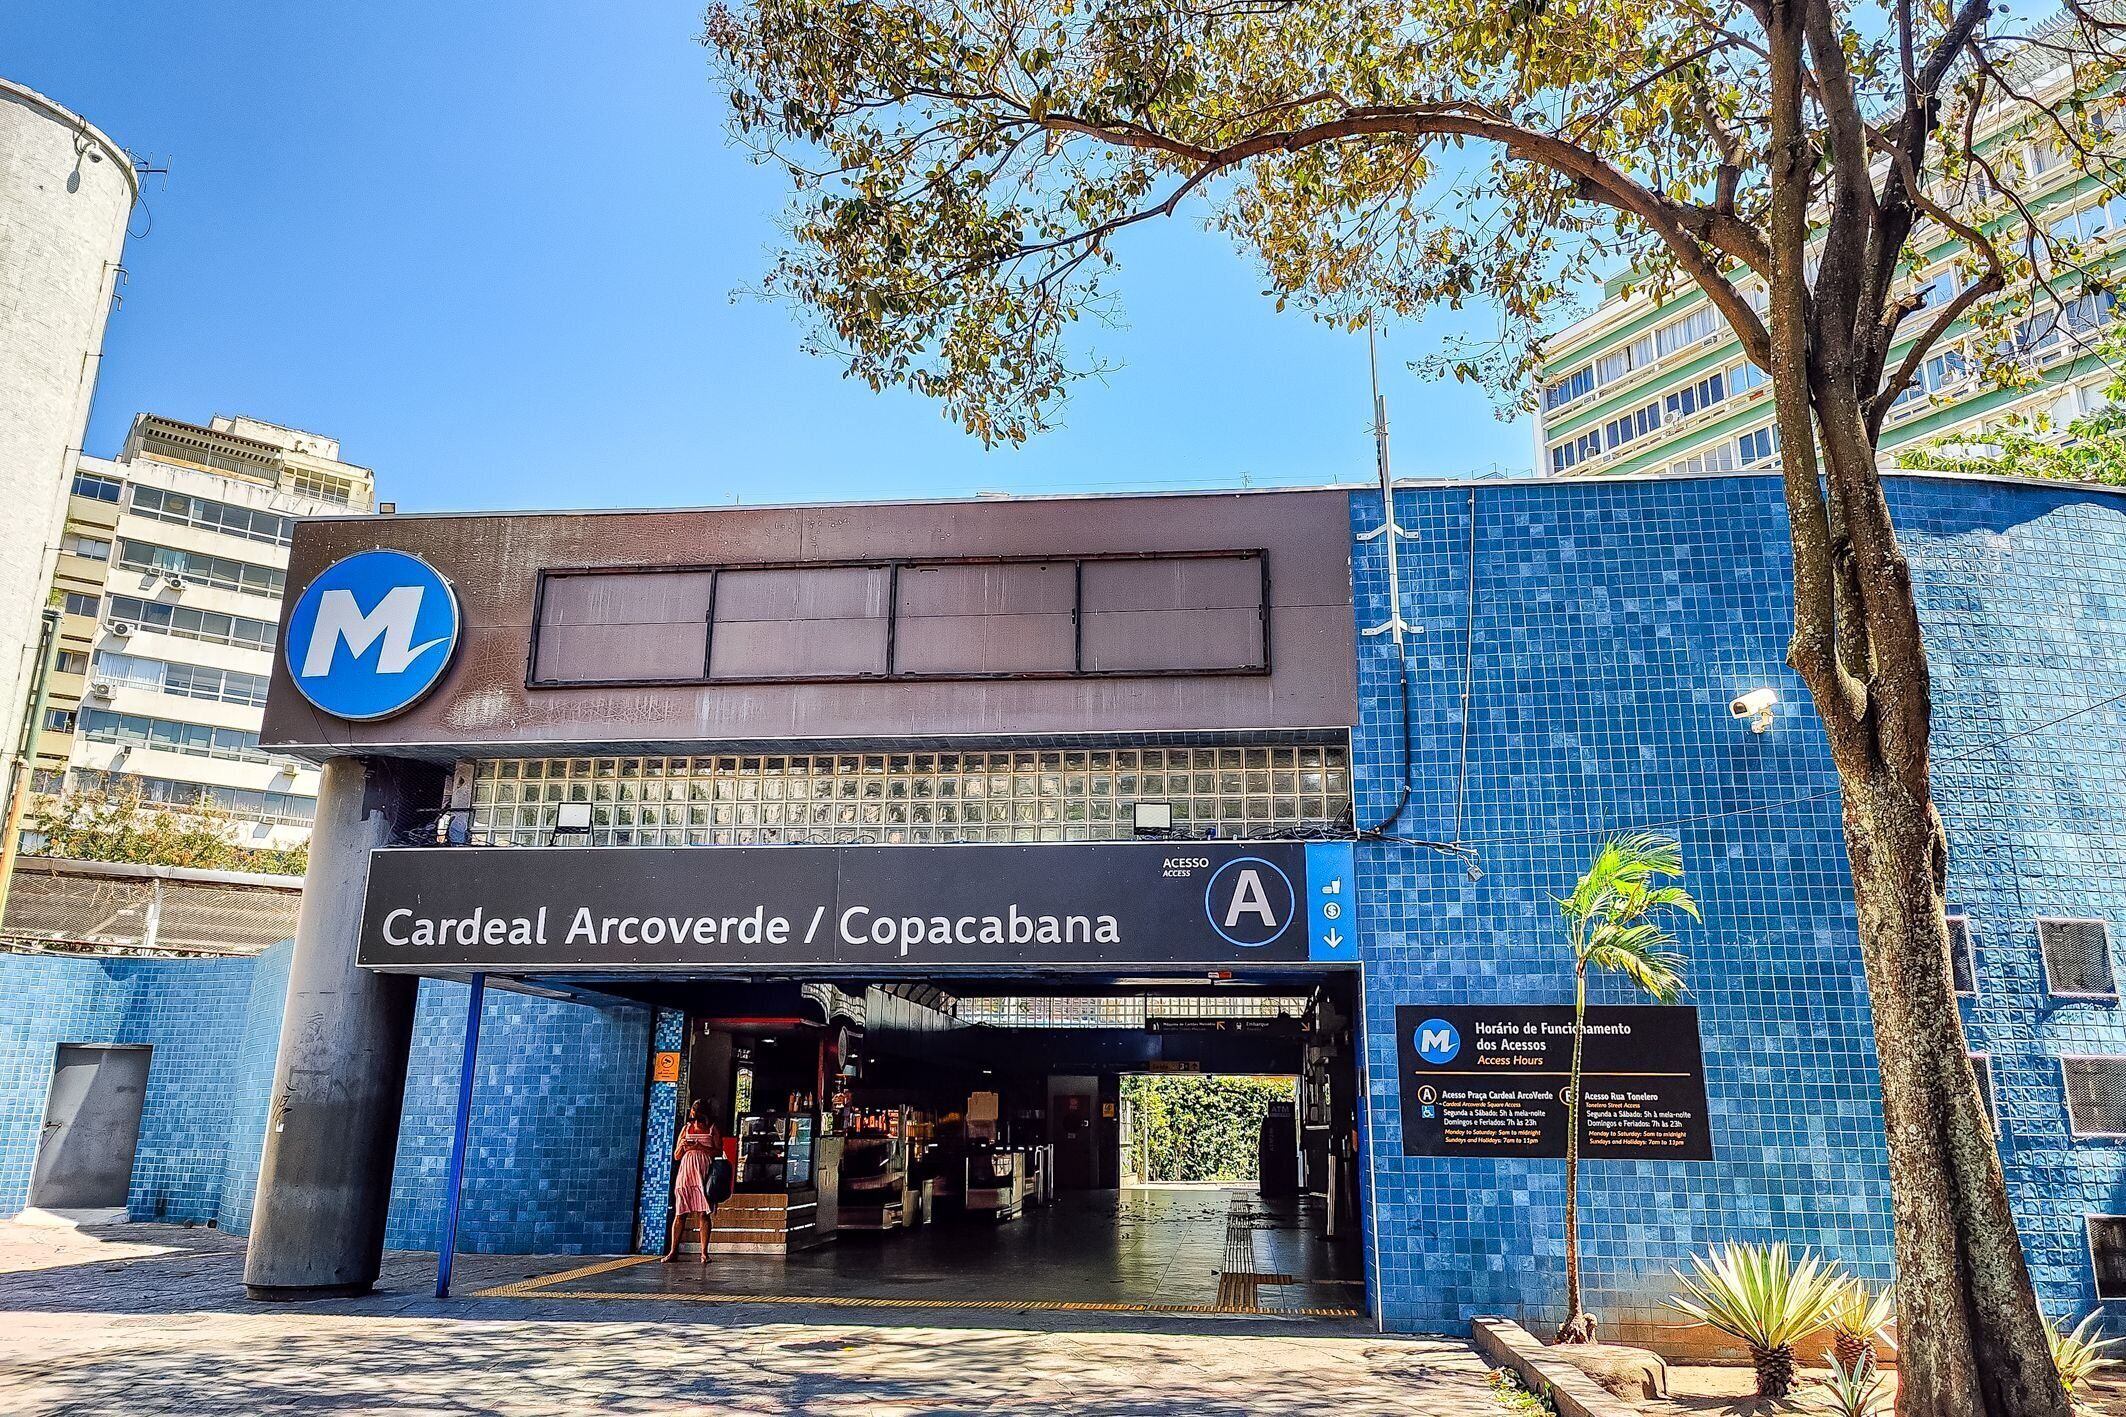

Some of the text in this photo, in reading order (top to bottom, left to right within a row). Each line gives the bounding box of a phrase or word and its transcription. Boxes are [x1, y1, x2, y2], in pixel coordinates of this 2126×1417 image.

[302, 586, 451, 677] M
[1163, 858, 1209, 868] ACESSO
[1224, 869, 1277, 927] A
[382, 904, 1121, 957] Cardeal Arcoverde / Copacabana
[1476, 1022, 1519, 1034] Horário
[1523, 1022, 1537, 1034] de
[1477, 1039, 1546, 1050] dos Acessos
[1478, 1055, 1543, 1065] Access Hours
[1423, 1089, 1431, 1100] A
[1442, 1090, 1553, 1100] Acesso Praça Cardeal ArcoVerde
[1584, 1092, 1658, 1100] Acesso Rua Tonelero
[1443, 1109, 1467, 1117] Segunda
[1587, 1110, 1611, 1119] Segunda
[1444, 1118, 1472, 1126] Domingos
[1587, 1120, 1616, 1128] Domingos
